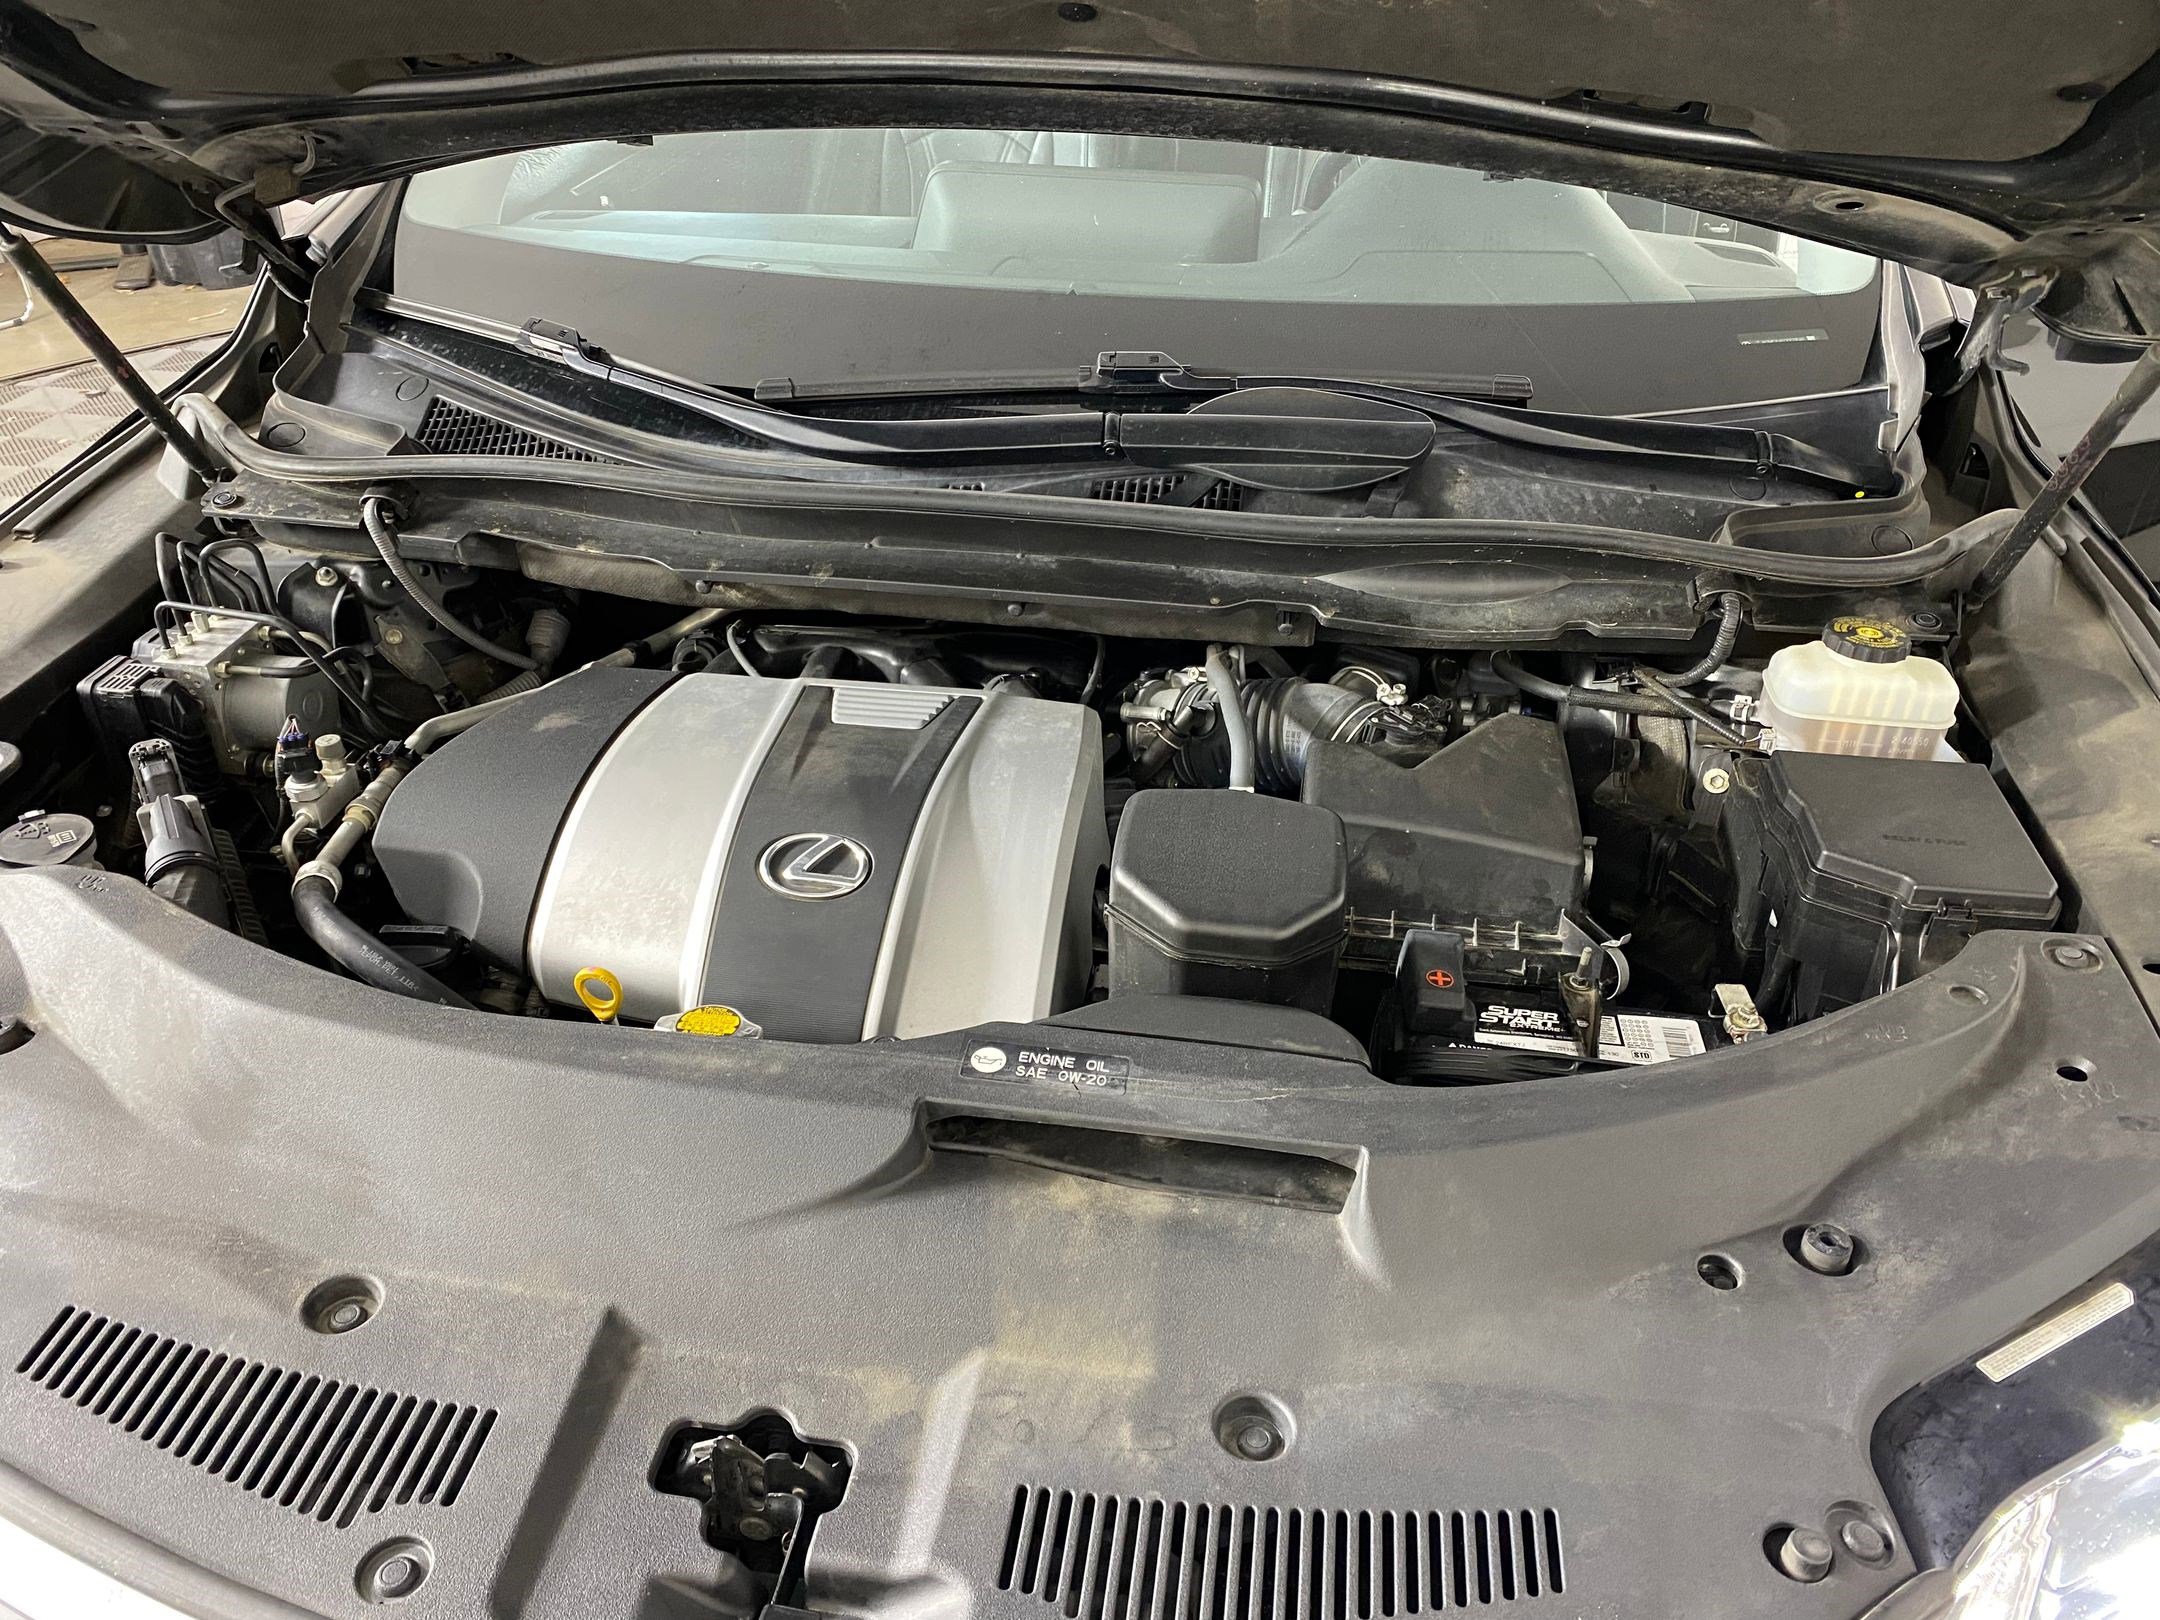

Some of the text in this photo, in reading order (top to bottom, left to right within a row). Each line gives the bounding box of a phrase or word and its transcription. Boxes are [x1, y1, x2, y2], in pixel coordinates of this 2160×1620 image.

[1479, 1012, 1560, 1028] START
[1487, 1005, 1558, 1021] SUPER
[1018, 1051, 1110, 1073] ENGINE OIL
[1015, 1065, 1108, 1087] SAE 0W-20
